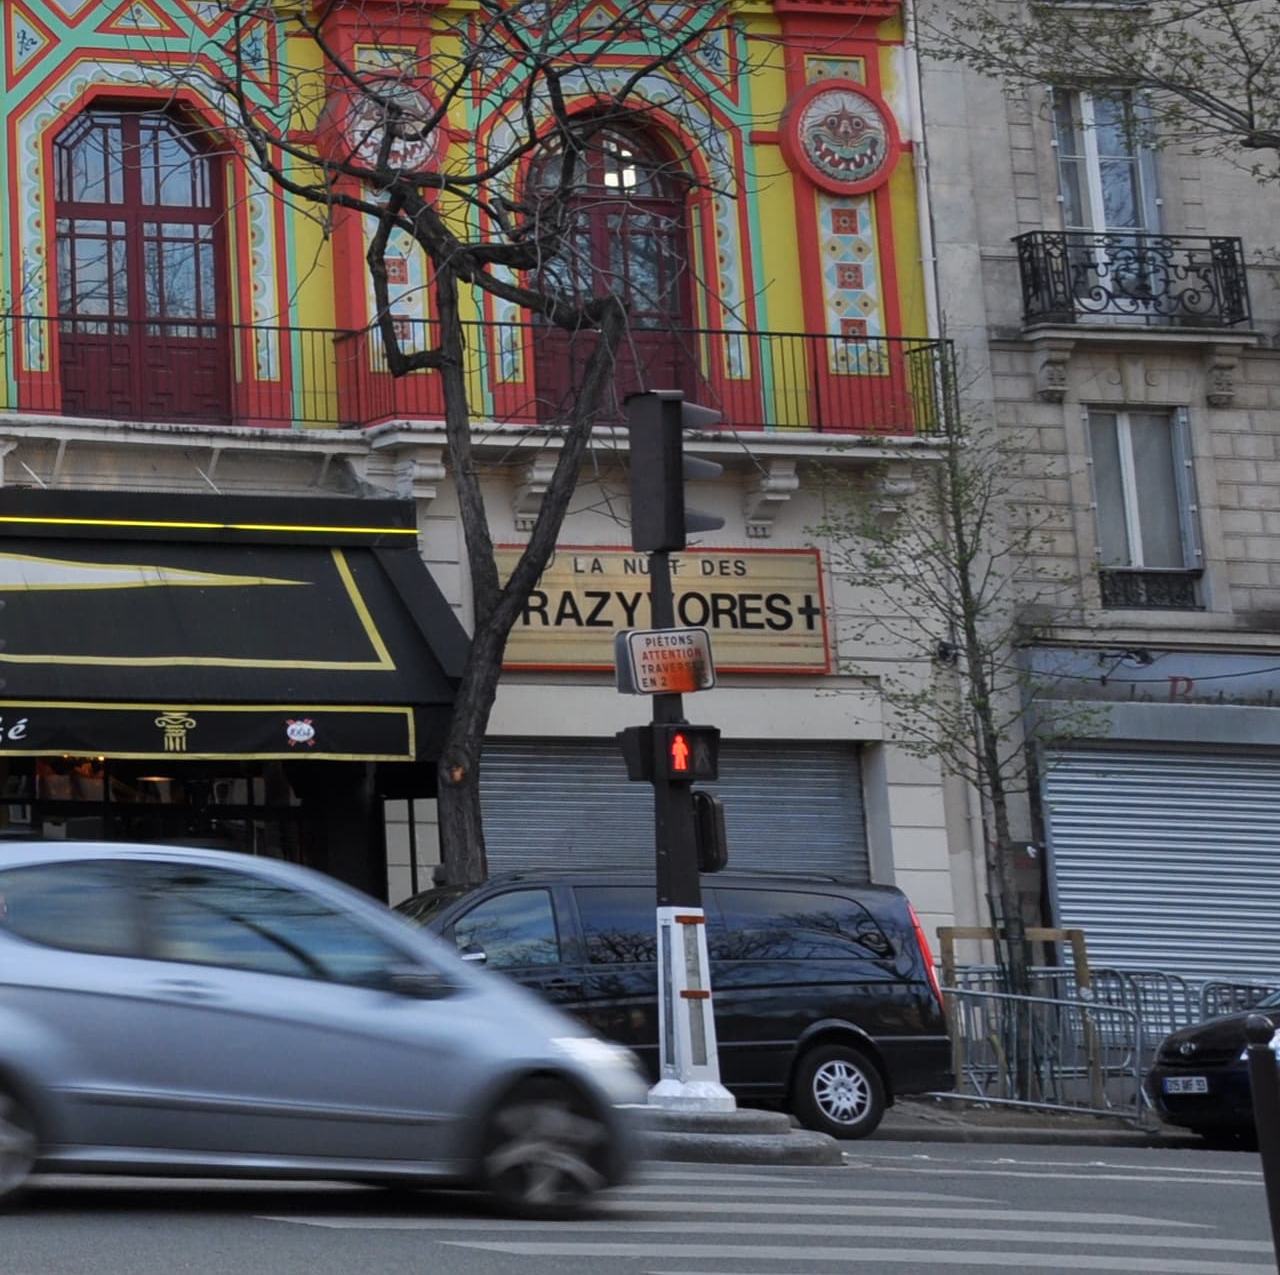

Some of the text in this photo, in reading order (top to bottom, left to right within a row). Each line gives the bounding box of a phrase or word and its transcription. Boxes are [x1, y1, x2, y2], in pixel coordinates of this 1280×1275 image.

[574, 557, 746, 576] LA NUT DES
[645, 635, 694, 647] PIÉTONS
[642, 647, 702, 662] ATTENTION
[642, 678, 656, 688] EN
